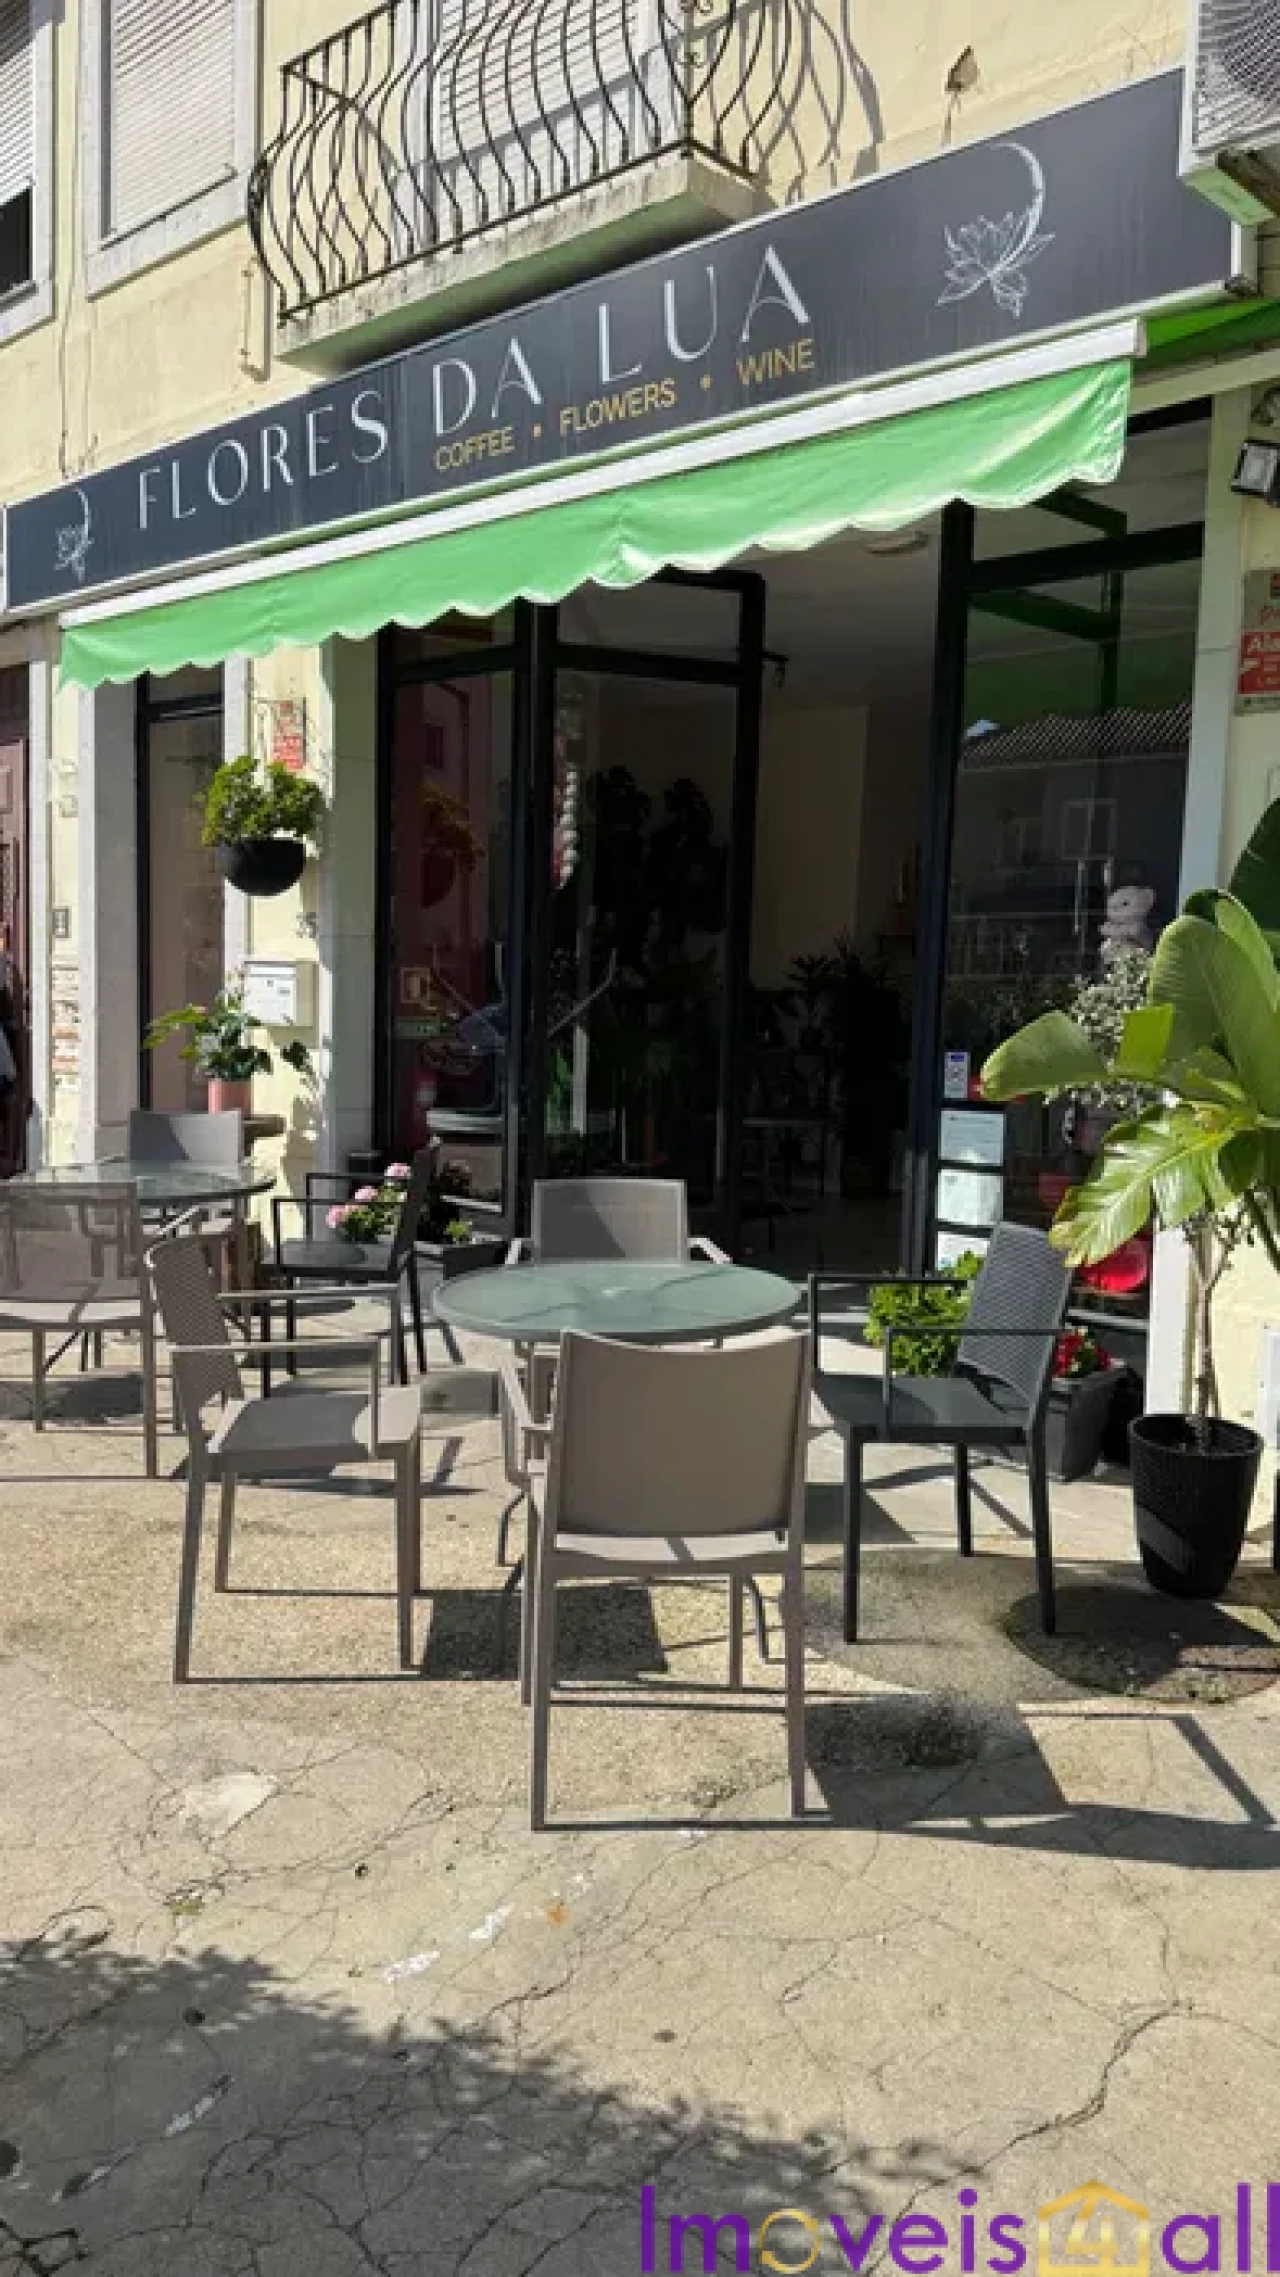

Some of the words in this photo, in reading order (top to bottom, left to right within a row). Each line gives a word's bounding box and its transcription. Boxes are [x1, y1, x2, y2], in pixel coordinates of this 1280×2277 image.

[138, 389, 389, 529] FLORES
[431, 337, 543, 437] DA
[598, 244, 811, 385] LUA
[435, 426, 516, 471] COFFEE
[559, 379, 677, 437] FLOWERS
[736, 338, 815, 386] WINE
